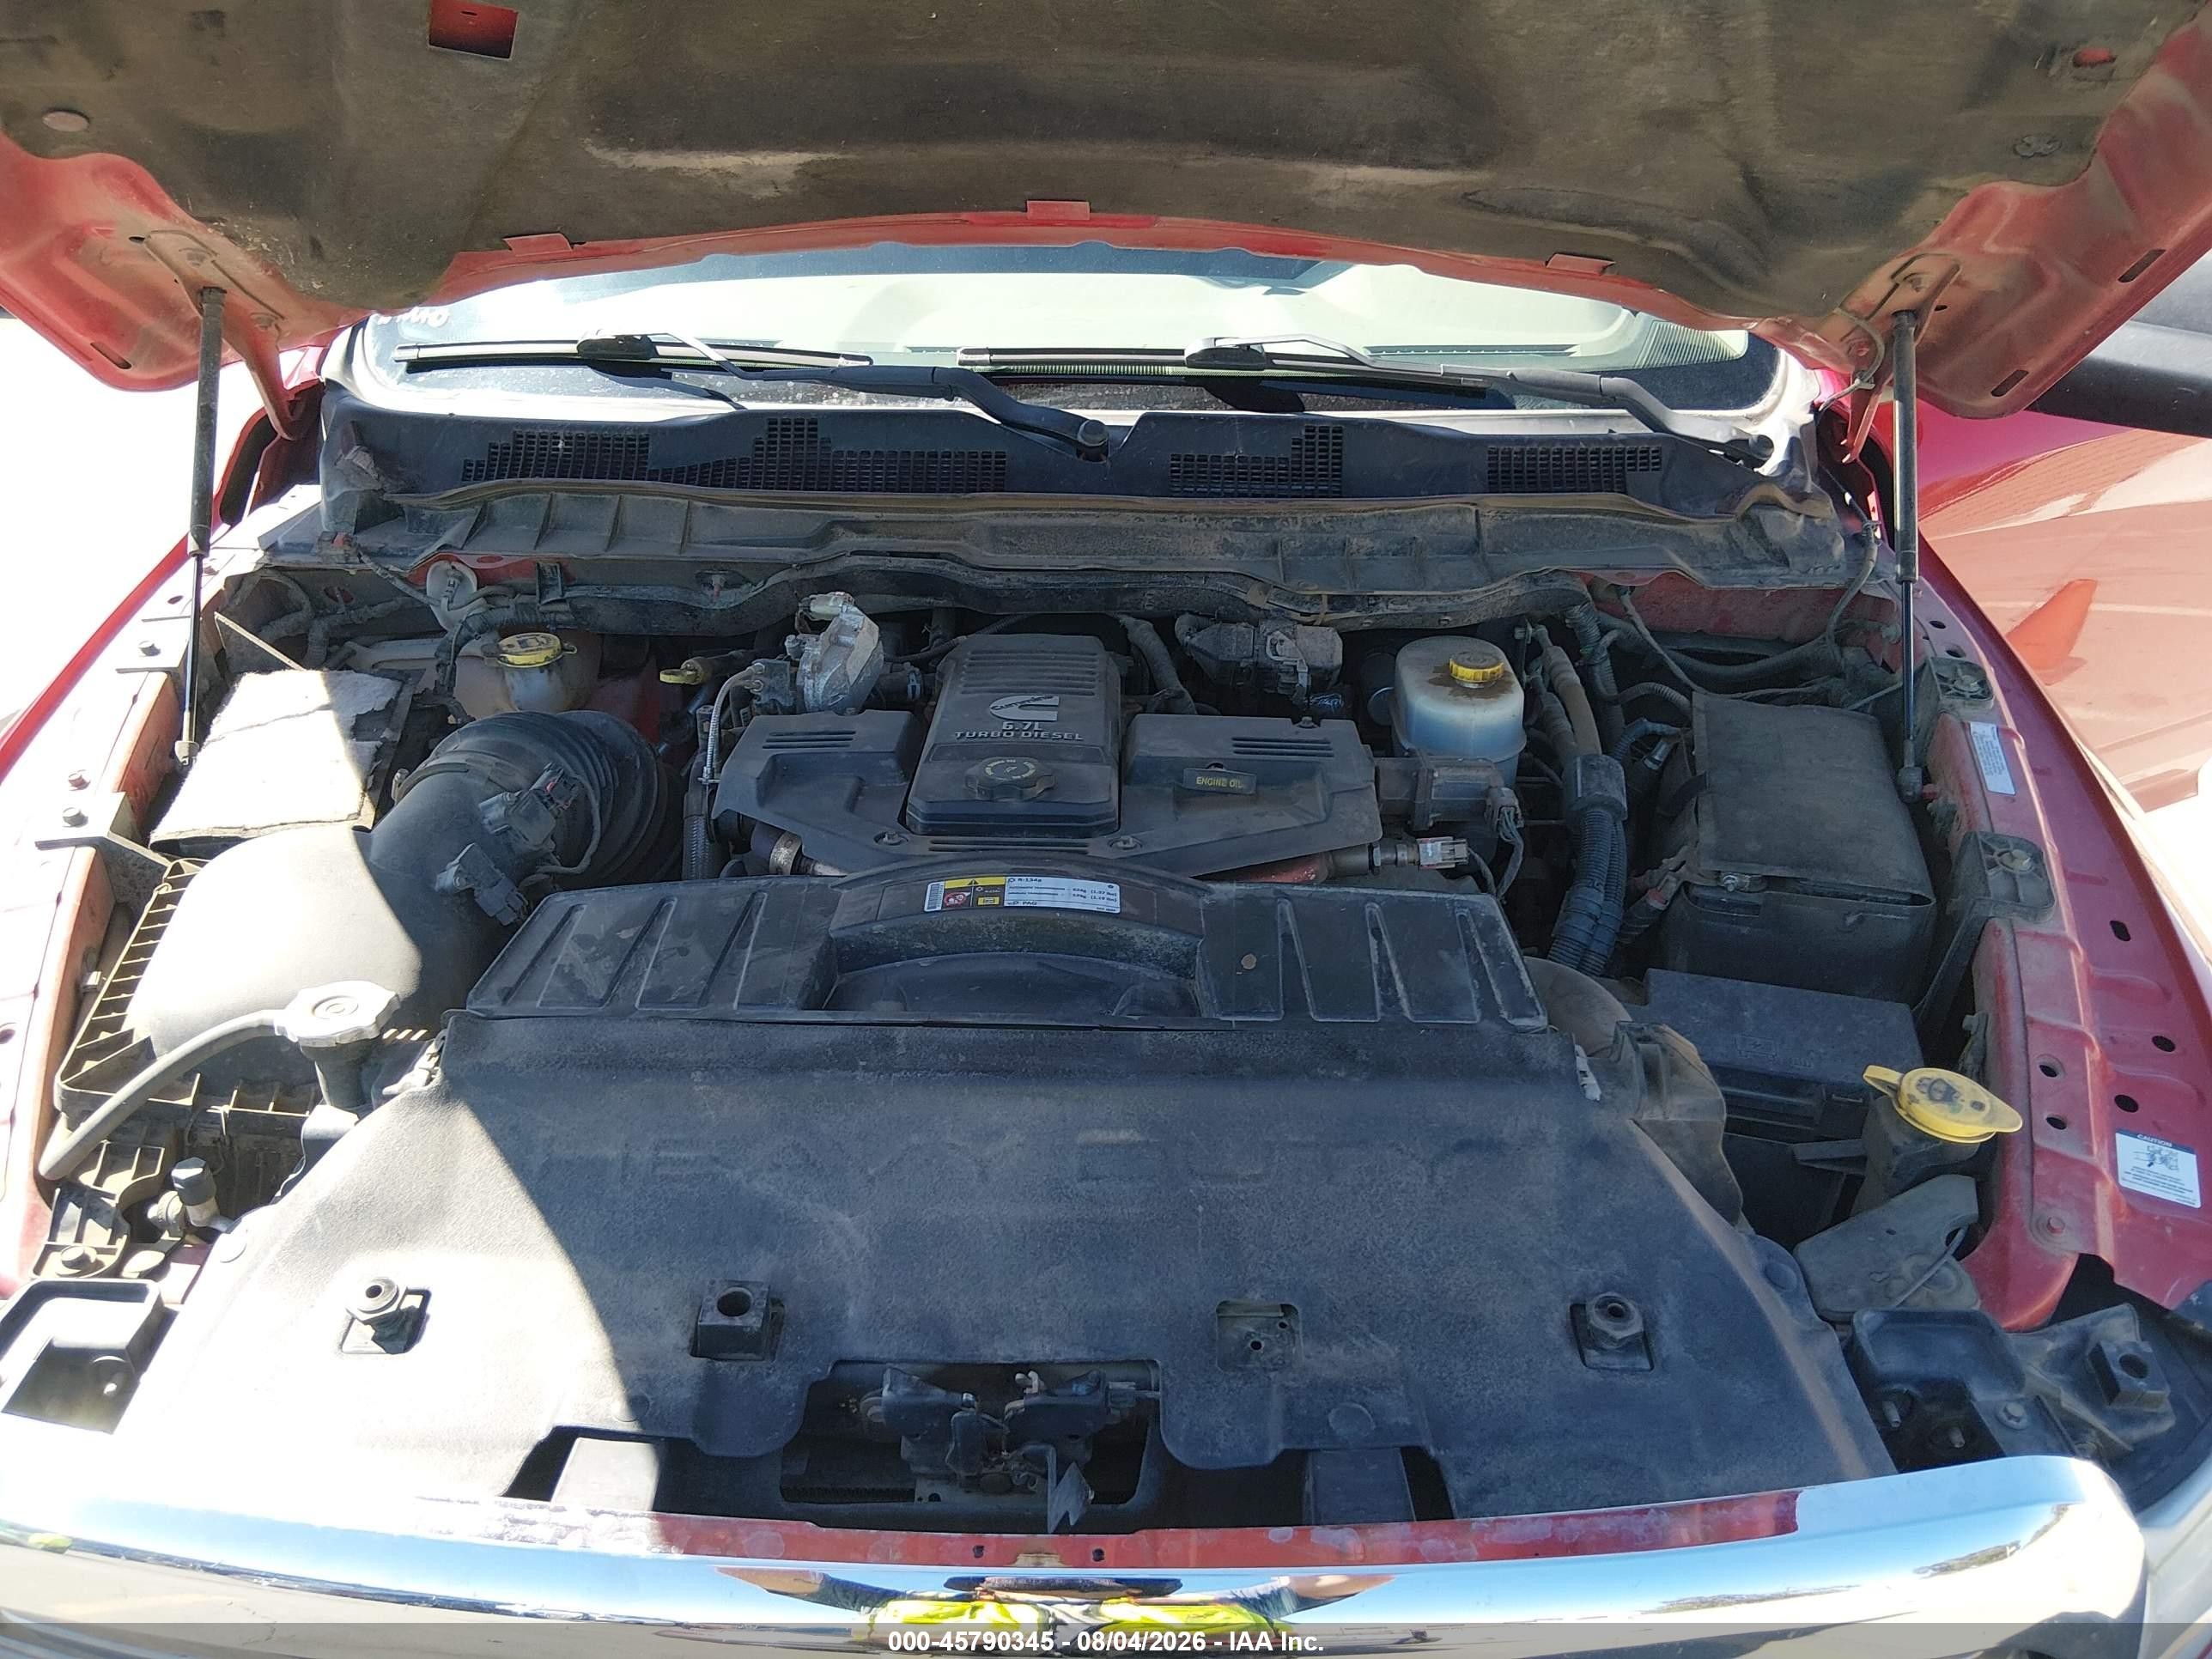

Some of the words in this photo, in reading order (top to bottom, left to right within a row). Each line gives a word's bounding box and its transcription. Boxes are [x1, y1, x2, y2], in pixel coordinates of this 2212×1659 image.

[1002, 721, 1043, 731] 6.7L
[955, 731, 1014, 739] TURBO
[1021, 731, 1084, 740] DIESEL
[1196, 776, 1227, 787] ENGINE
[1229, 778, 1243, 788] OIL
[2136, 1133, 2172, 1147] CAUTION
